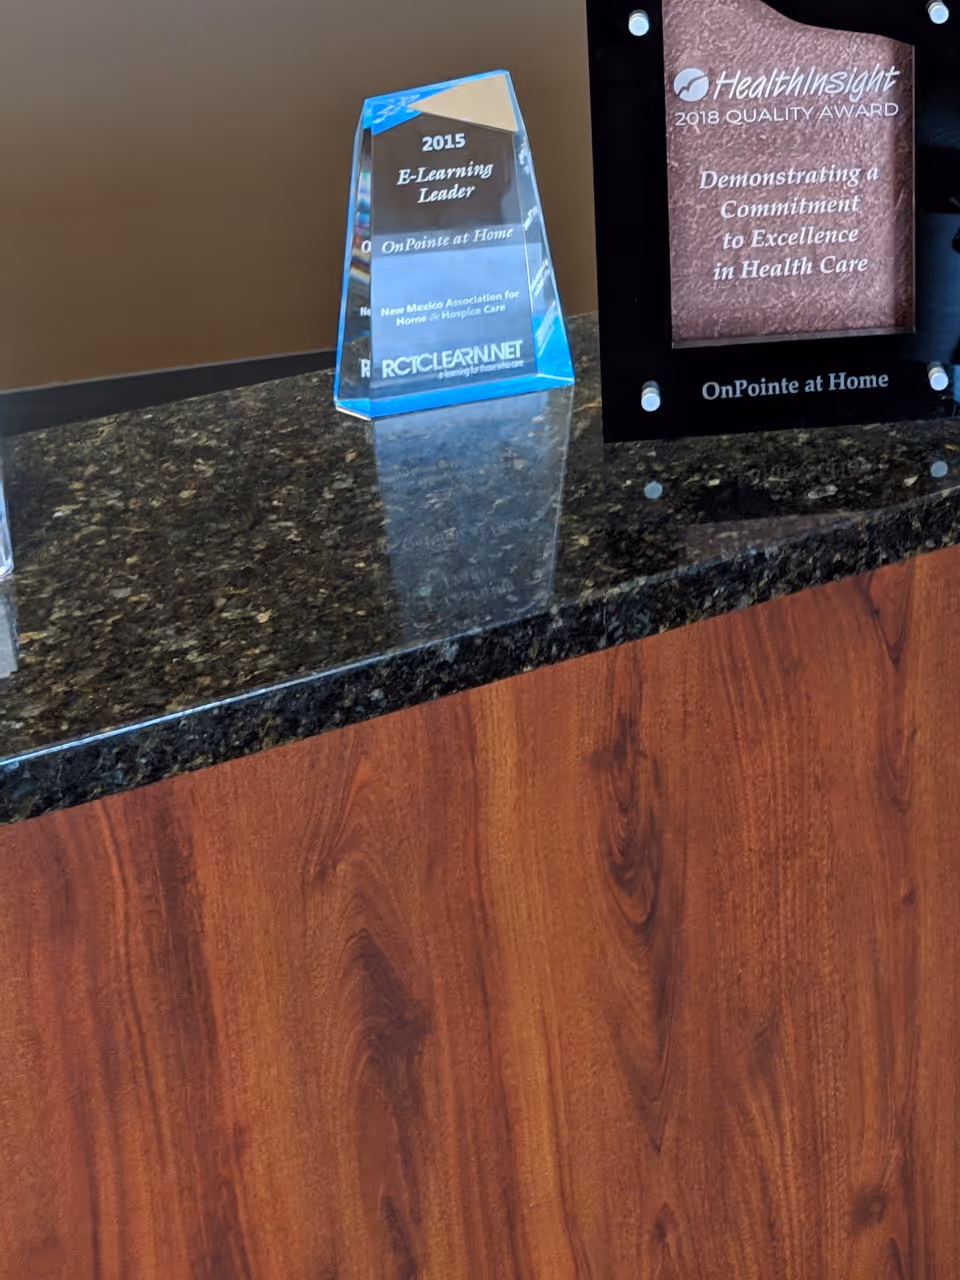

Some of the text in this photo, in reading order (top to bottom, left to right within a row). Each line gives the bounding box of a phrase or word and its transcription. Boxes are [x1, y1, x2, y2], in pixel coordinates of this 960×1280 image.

[712, 64, 901, 102] HealthInsight
[674, 102, 900, 126] 2018 QUALITY AWARD
[421, 133, 466, 152] 2015
[396, 161, 494, 186] E-Learning
[699, 163, 880, 190] Demonstrating a
[417, 183, 476, 204] Leader
[720, 194, 861, 220] Commitment
[381, 233, 449, 255] OnPointe
[452, 233, 470, 246] at
[472, 227, 514, 244] Home
[722, 226, 860, 250] to Excellence
[712, 255, 869, 281] in Health Care
[381, 306, 404, 317] New
[406, 300, 443, 314] Mexico
[446, 293, 503, 308] Association
[505, 290, 520, 300] for
[396, 314, 427, 327] Home
[441, 307, 481, 321] Hospice
[483, 304, 506, 314] Care
[701, 371, 890, 400] OnPointe at Home
